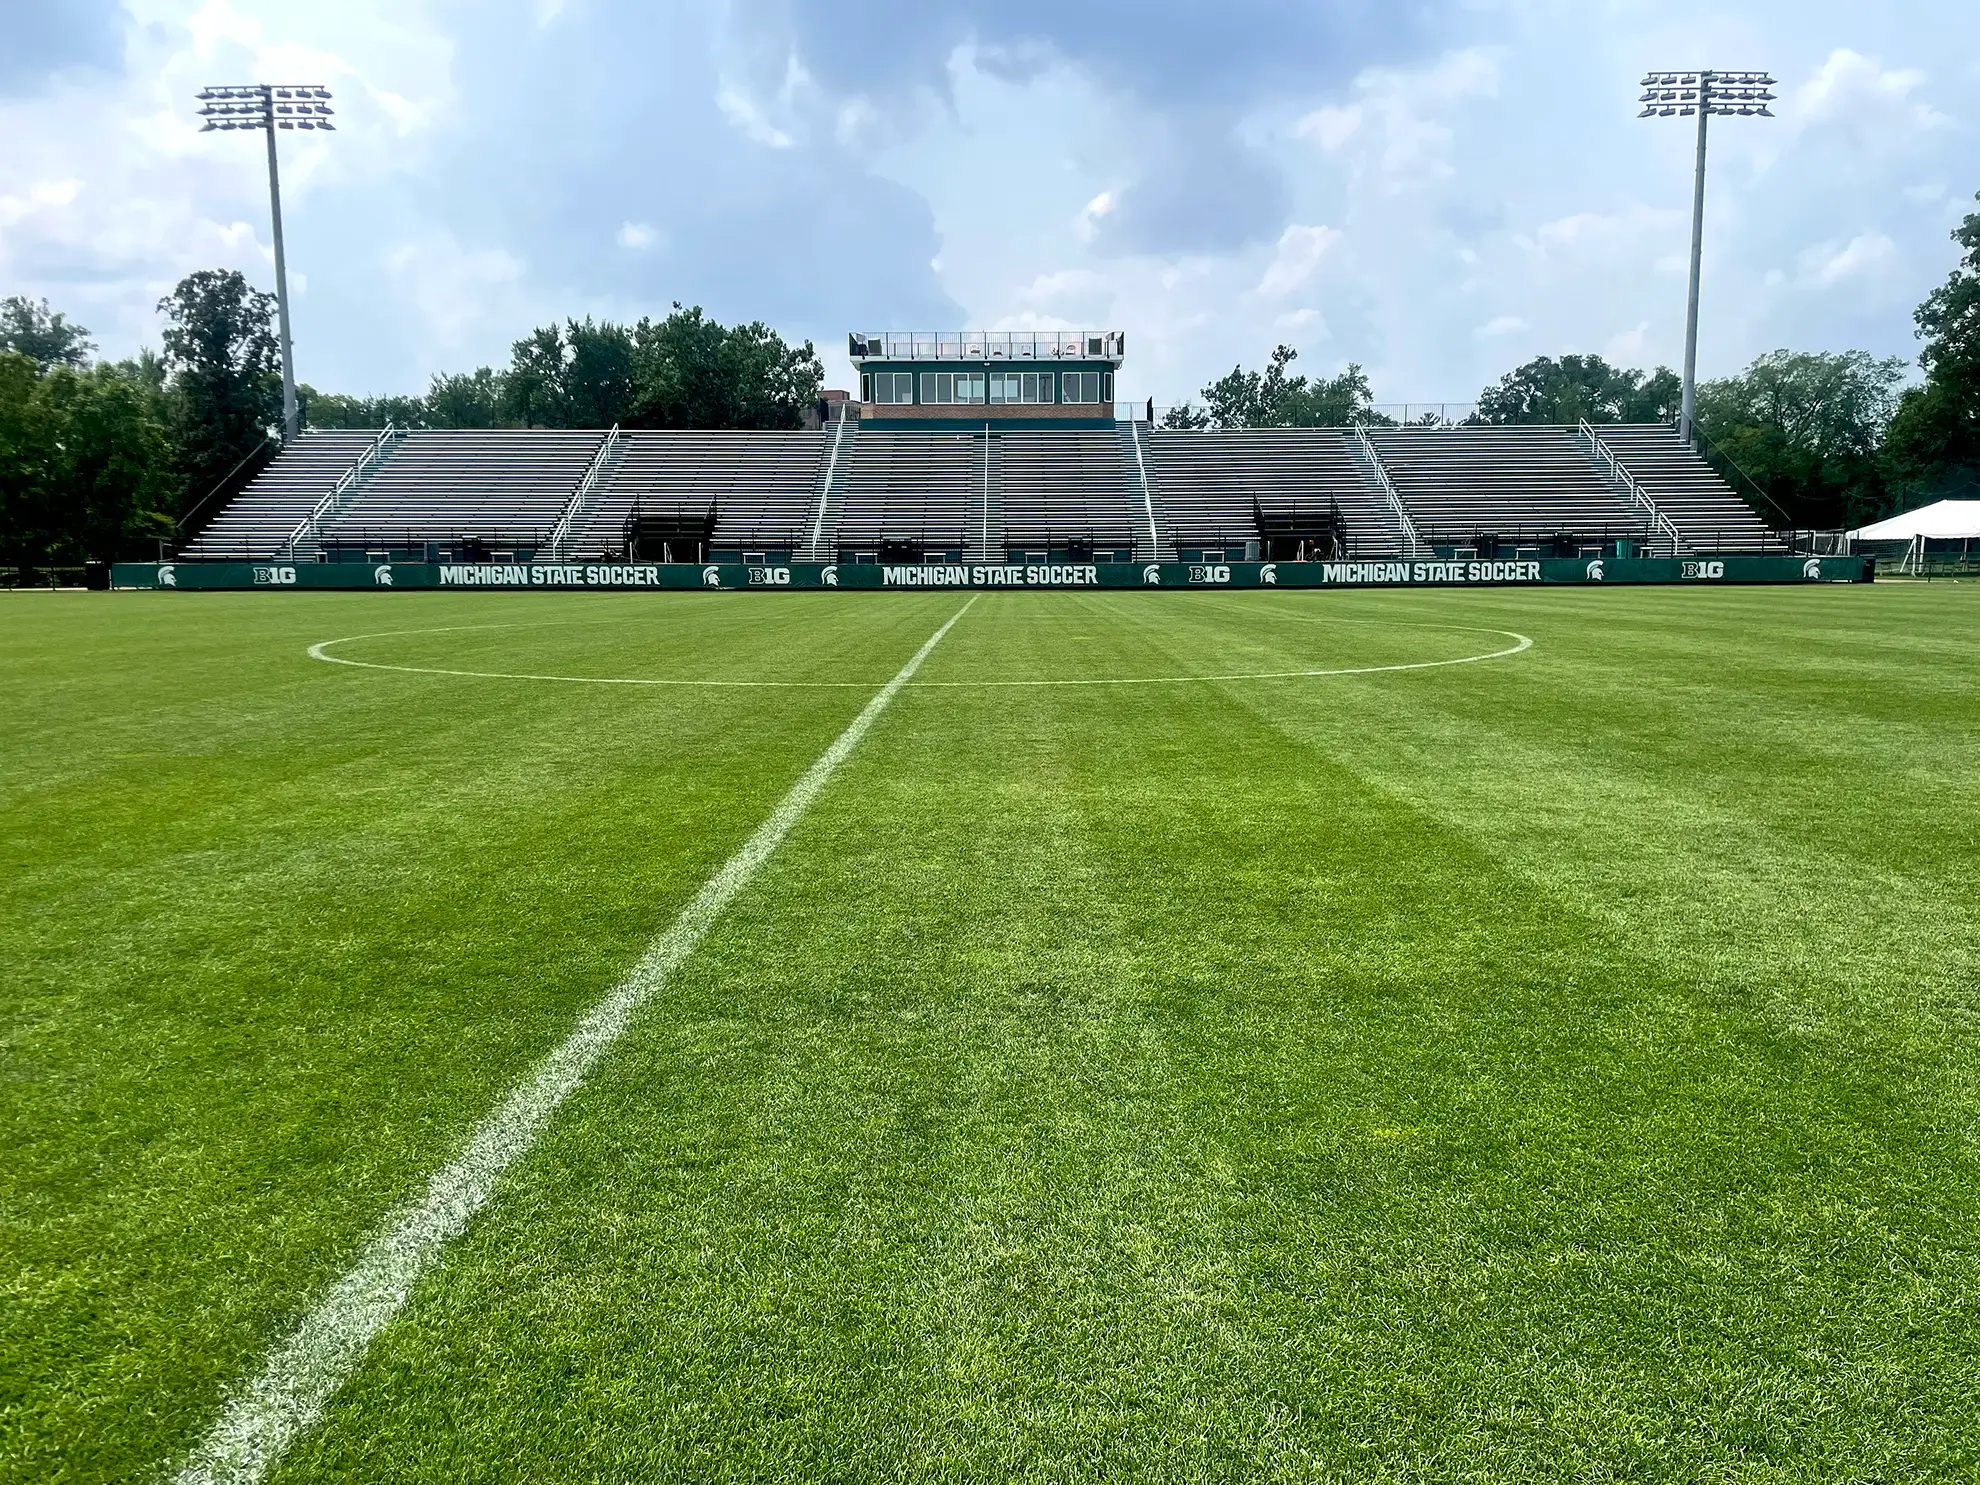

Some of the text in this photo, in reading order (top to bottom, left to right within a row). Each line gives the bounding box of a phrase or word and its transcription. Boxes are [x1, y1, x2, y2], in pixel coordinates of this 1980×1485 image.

[439, 566, 660, 585] MICHIGAN STATE SOCCER
[882, 566, 1098, 585] MICHIGAN STATE SOCCER
[1322, 561, 1541, 583] MICHIGAN STATE SOCCER
